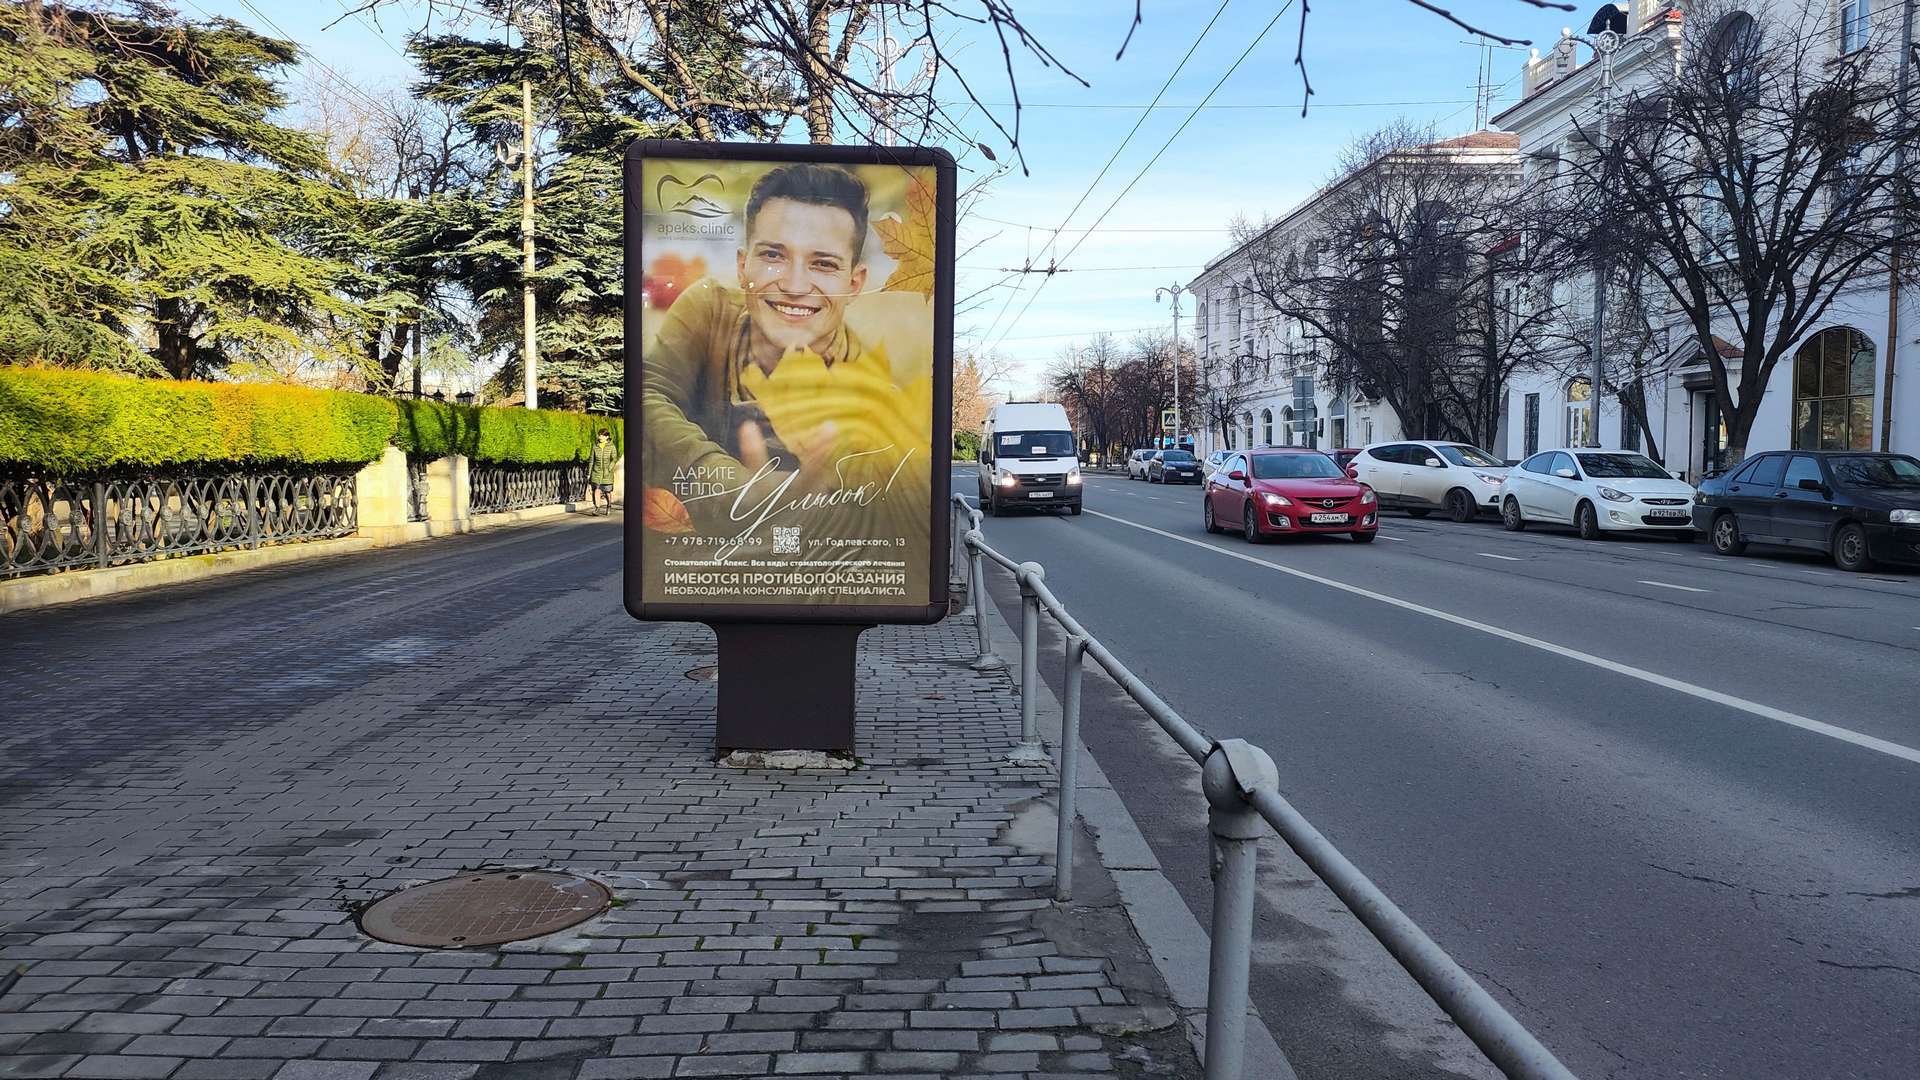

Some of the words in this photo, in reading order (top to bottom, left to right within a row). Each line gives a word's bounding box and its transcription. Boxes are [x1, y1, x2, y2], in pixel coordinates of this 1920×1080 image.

[657, 222, 735, 236] apeks.clinic
[673, 466, 737, 480] ДАРИТЕ
[673, 482, 725, 496] ТЕПЛО
[665, 536, 678, 546] +7
[808, 539, 824, 549] ул.
[895, 538, 906, 547] 13
[664, 559, 722, 567] Стоматология
[664, 573, 740, 584] ИМЕЮТСЯ
[743, 573, 906, 585] ПРОТИВОПОКАЗАНИЯ
[664, 586, 741, 596] НЕОБХОДИМА
[743, 586, 826, 597] КОНСУЛЬТАЦИЯ
[828, 586, 906, 596] СПЕЦИАЛИСТА
